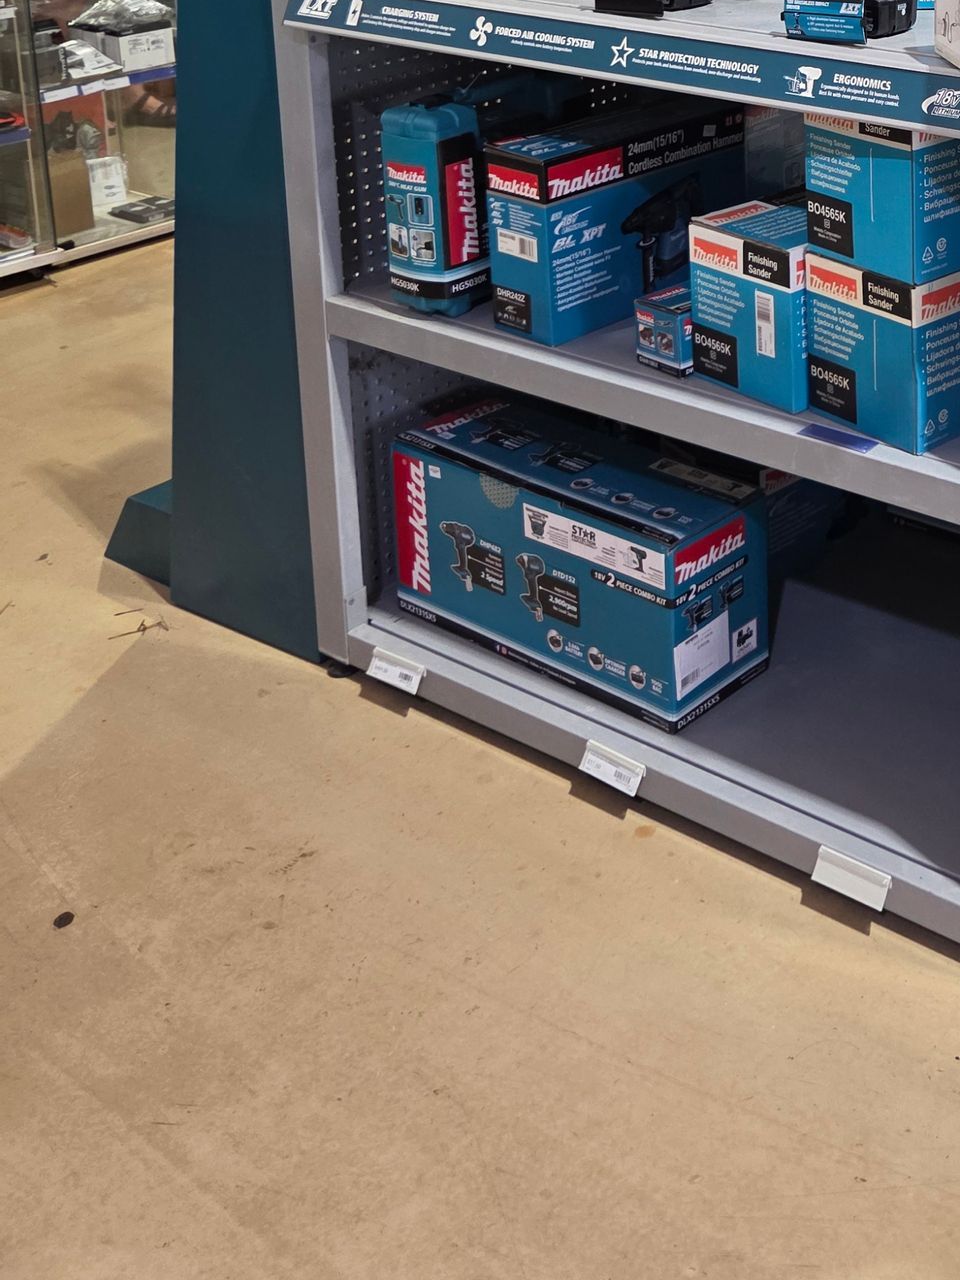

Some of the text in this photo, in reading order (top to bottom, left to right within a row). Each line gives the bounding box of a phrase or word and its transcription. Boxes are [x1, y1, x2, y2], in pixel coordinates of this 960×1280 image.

[382, 6, 439, 22] CHARGING SYSTEM
[495, 26, 521, 38] FORCED
[521, 30, 535, 39] AIR
[535, 32, 566, 45] COOLING
[567, 37, 595, 49] SYSTEM
[639, 48, 658, 59] STAR
[659, 50, 706, 67] PROTECTION
[706, 57, 759, 74] TECHNOLOGY
[833, 73, 892, 91] ERGONOMICS
[864, 122, 890, 137] Sander
[628, 131, 743, 175] Cordless Combination Hammer
[808, 200, 847, 224] BO4565K
[748, 251, 778, 272] Finishing
[748, 264, 772, 280] Sander
[391, 276, 420, 293] HG5030K
[452, 273, 488, 294] HG5030K
[868, 282, 900, 303] Finishing
[868, 295, 894, 311] Sander
[925, 321, 958, 339] Finishing
[694, 332, 732, 356] BO4565K
[811, 364, 850, 390] BO4565K
[552, 569, 576, 584] DTD152
[676, 558, 745, 606] 18V 2 PIECE COMBO KIT
[594, 571, 667, 606] 18V 2 PIECE COMBO KIT
